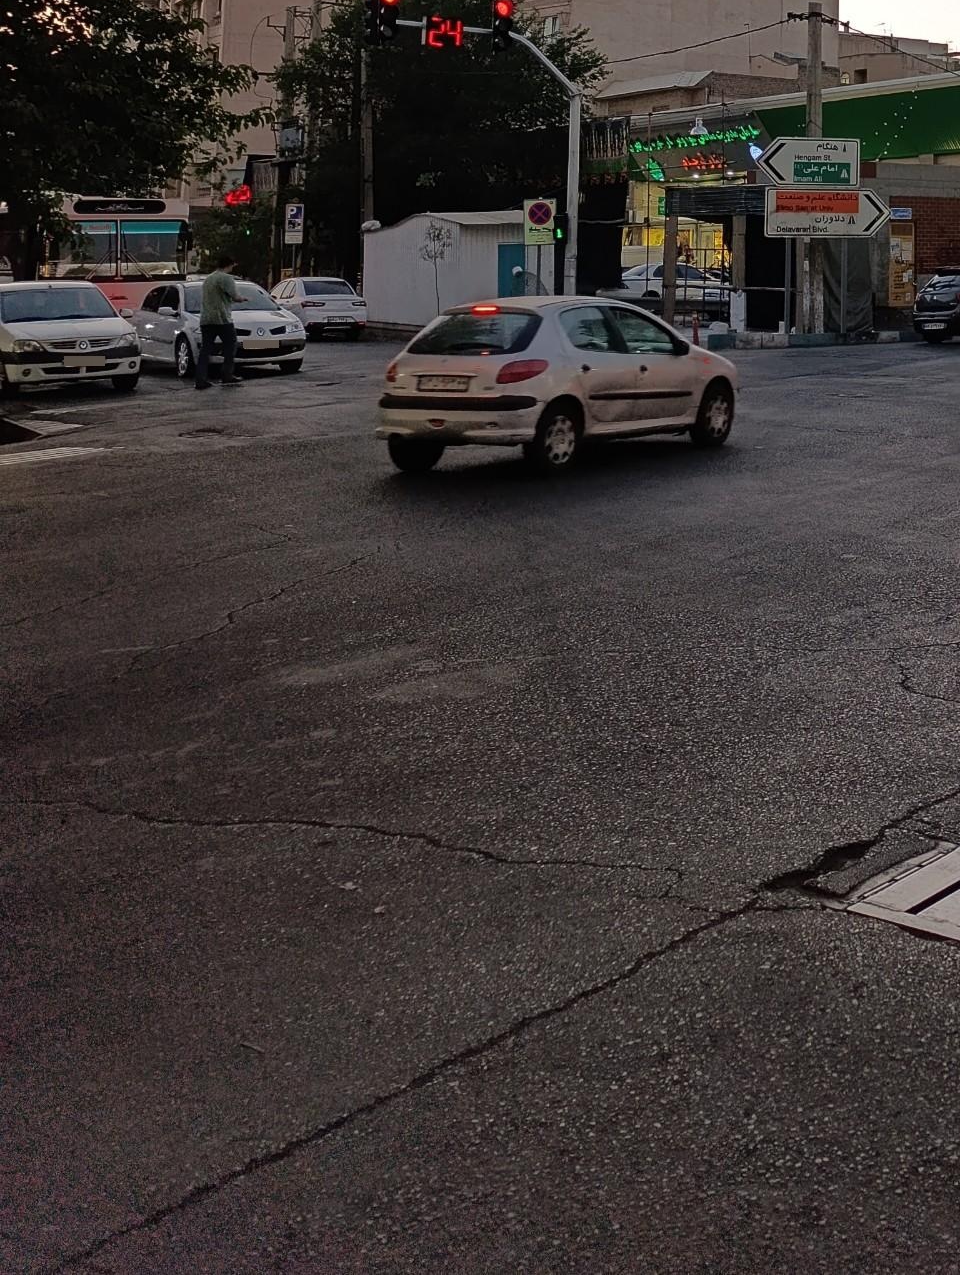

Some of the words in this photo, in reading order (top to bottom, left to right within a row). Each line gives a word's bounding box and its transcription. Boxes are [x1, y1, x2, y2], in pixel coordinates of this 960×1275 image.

[429, 16, 462, 47] 24
[816, 143, 839, 152] هنگام
[794, 154, 822, 162] Hengam
[803, 163, 819, 174] علی
[820, 164, 838, 174] امام
[828, 192, 858, 201] دانشگاه
[814, 215, 845, 224] دلاوران
[776, 225, 811, 233] Delavaran
[812, 225, 829, 233] Blvd.
